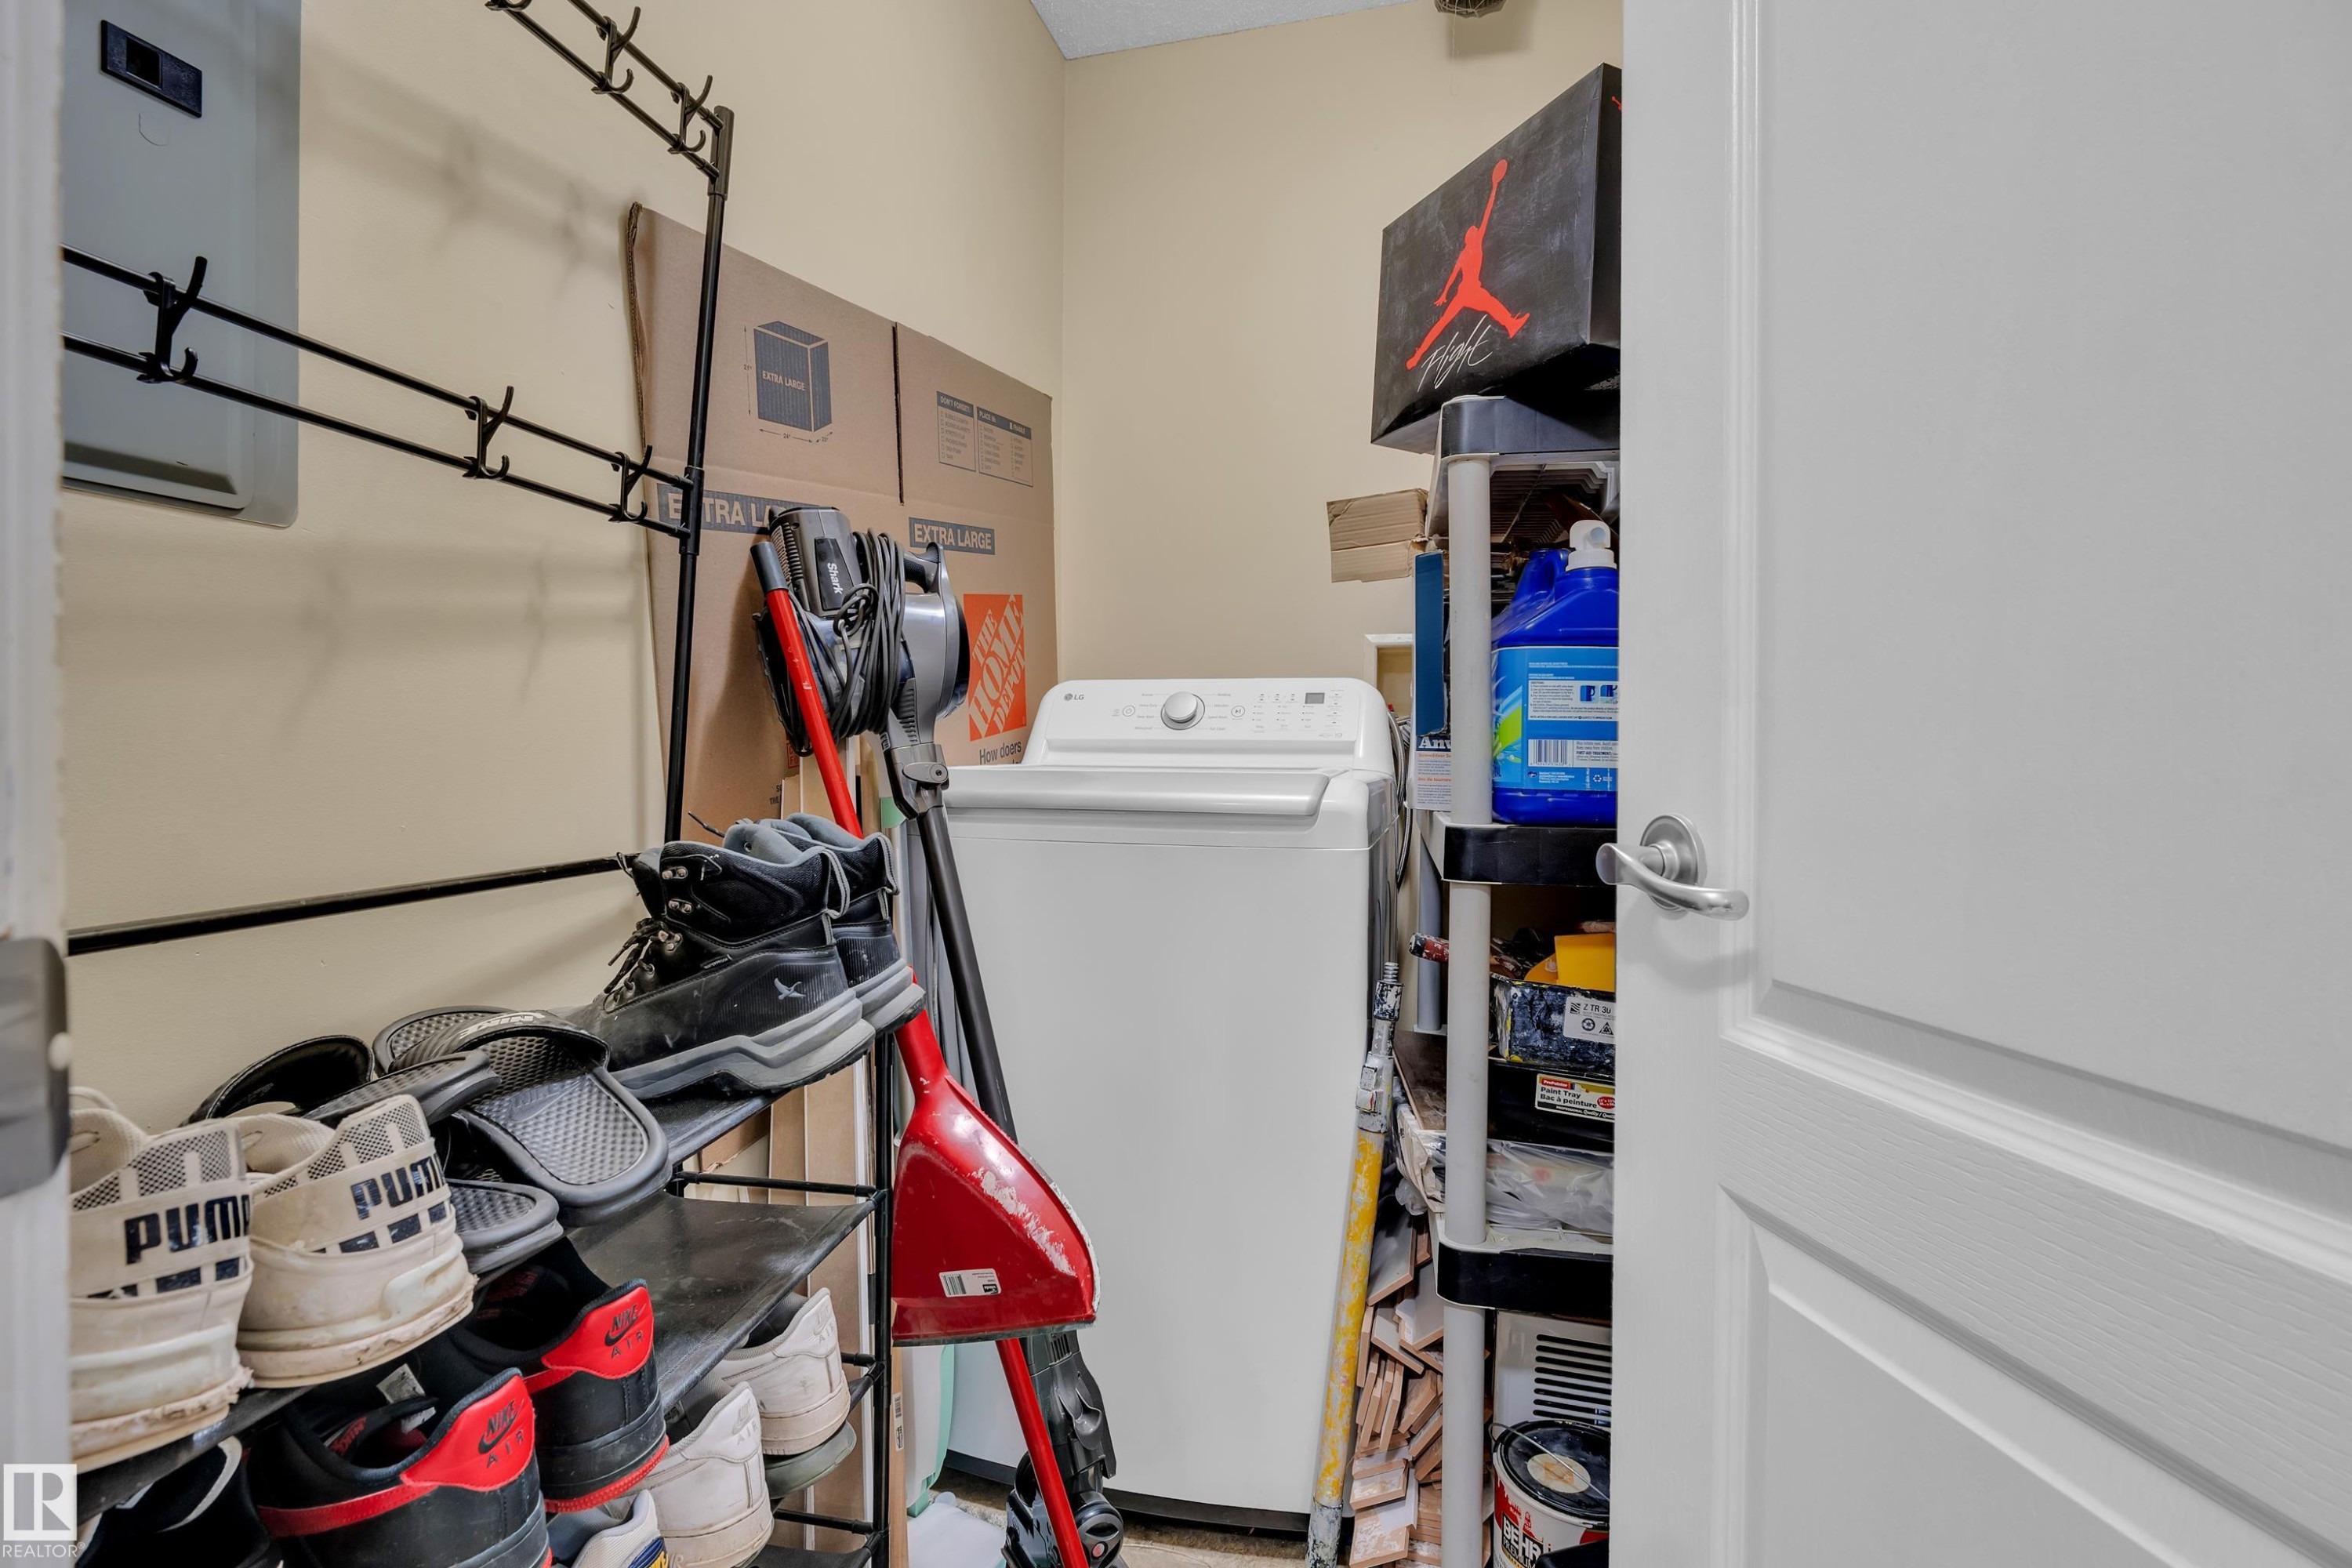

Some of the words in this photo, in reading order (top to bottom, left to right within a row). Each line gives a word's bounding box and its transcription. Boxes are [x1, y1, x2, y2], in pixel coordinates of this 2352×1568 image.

[1417, 314, 1494, 392] Flight
[762, 369, 783, 385] EXTRA
[785, 376, 806, 391] LARGE
[940, 395, 953, 407] DON'T
[978, 410, 991, 421] PLACE
[668, 492, 746, 526] ETRA
[914, 523, 955, 546] EXTRA
[957, 528, 992, 550] LARGE
[827, 562, 844, 594] Shark
[971, 608, 997, 666] THE
[968, 593, 1023, 739] HOME
[993, 643, 1025, 734] DEPOT
[979, 748, 999, 765] How
[1000, 741, 1022, 758] doers
[1541, 1087, 1562, 1096] Paint
[1563, 1091, 1581, 1099] Tray
[1563, 1098, 1597, 1109] peinture
[612, 1304, 638, 1333] NIKE
[611, 1330, 644, 1359] AIR
[486, 1399, 516, 1438] NIKE
[486, 1430, 524, 1469] AIR
[1503, 1515, 1542, 1563] BEHR
